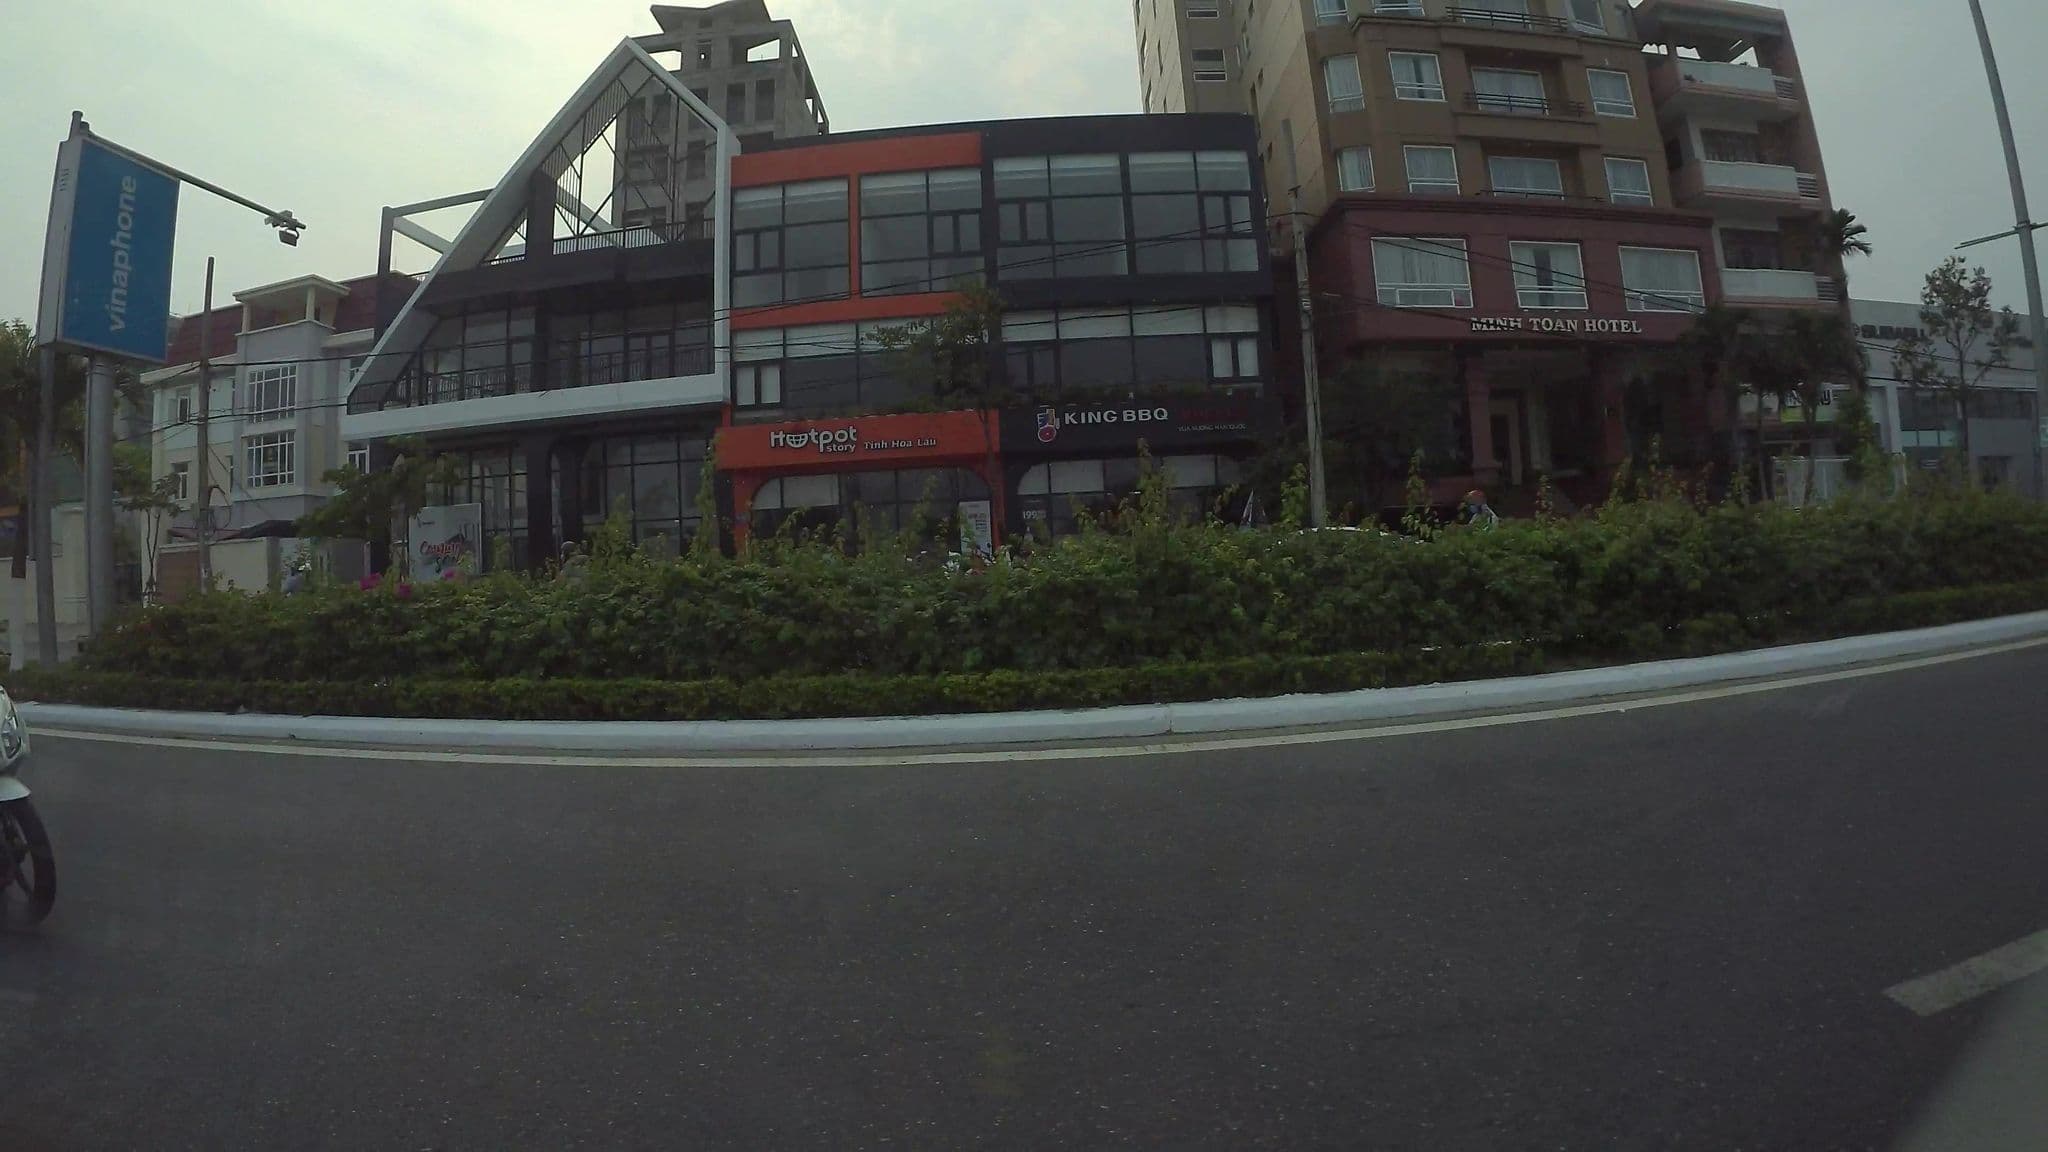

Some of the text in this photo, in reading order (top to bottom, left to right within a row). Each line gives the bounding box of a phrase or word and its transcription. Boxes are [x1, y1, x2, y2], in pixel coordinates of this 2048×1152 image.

[105, 175, 137, 331] vinaphone
[1471, 317, 1643, 333] MINH TOAN HOTEL
[1064, 410, 1118, 425] KING
[1122, 407, 1169, 422] BBQ
[770, 425, 858, 453] Hotpot
[864, 440, 888, 450] Tinh
[891, 439, 913, 449] Hoa
[826, 443, 857, 453] story
